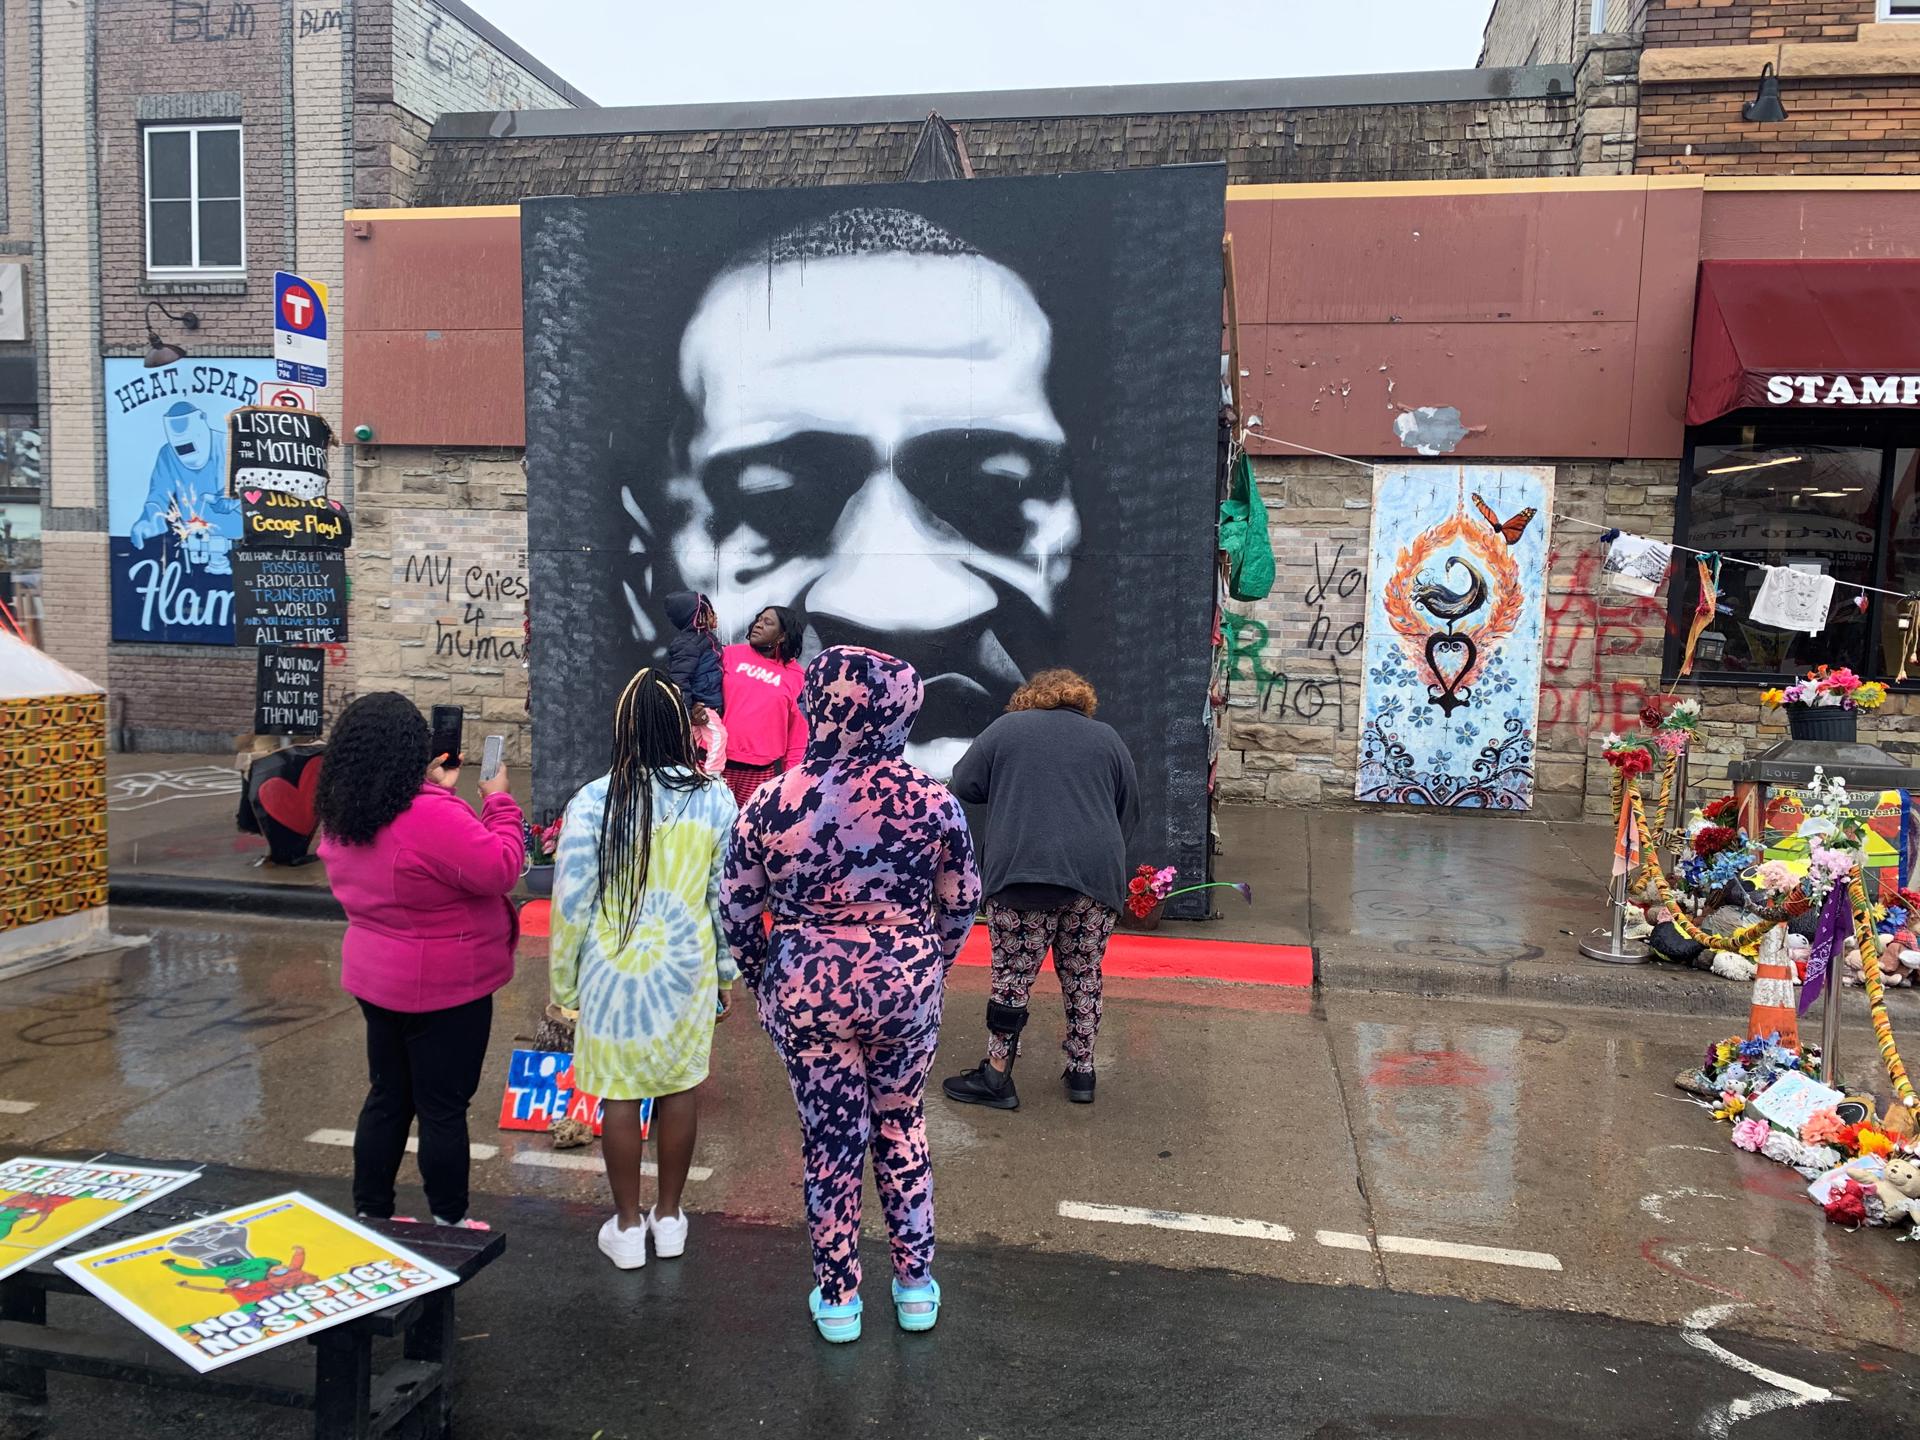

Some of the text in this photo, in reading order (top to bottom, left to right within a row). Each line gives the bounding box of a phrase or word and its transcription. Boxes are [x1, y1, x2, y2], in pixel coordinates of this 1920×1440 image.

[299, 9, 341, 38] BLM
[286, 334, 293, 345] 5
[114, 367, 188, 413] HEAT,
[191, 366, 259, 406] SPAR
[304, 514, 343, 540] Floyd
[281, 549, 298, 562] ACT
[465, 565, 528, 601] Cries
[1305, 542, 1367, 606] Yo
[128, 559, 236, 631] Flam
[274, 602, 327, 617] WORLD
[256, 627, 283, 644] ALL
[264, 655, 321, 673] IF NOT NOW
[736, 662, 781, 687] PUMA
[263, 690, 273, 703] IF
[277, 691, 300, 705] NOT
[1766, 769, 1800, 780] LOVE
[1780, 805, 1797, 814] So
[523, 1055, 574, 1078] LOV
[508, 1086, 571, 1123] THE
[190, 1258, 404, 1339] NO JUSTICE
[198, 1267, 436, 1359] NO STREETS
